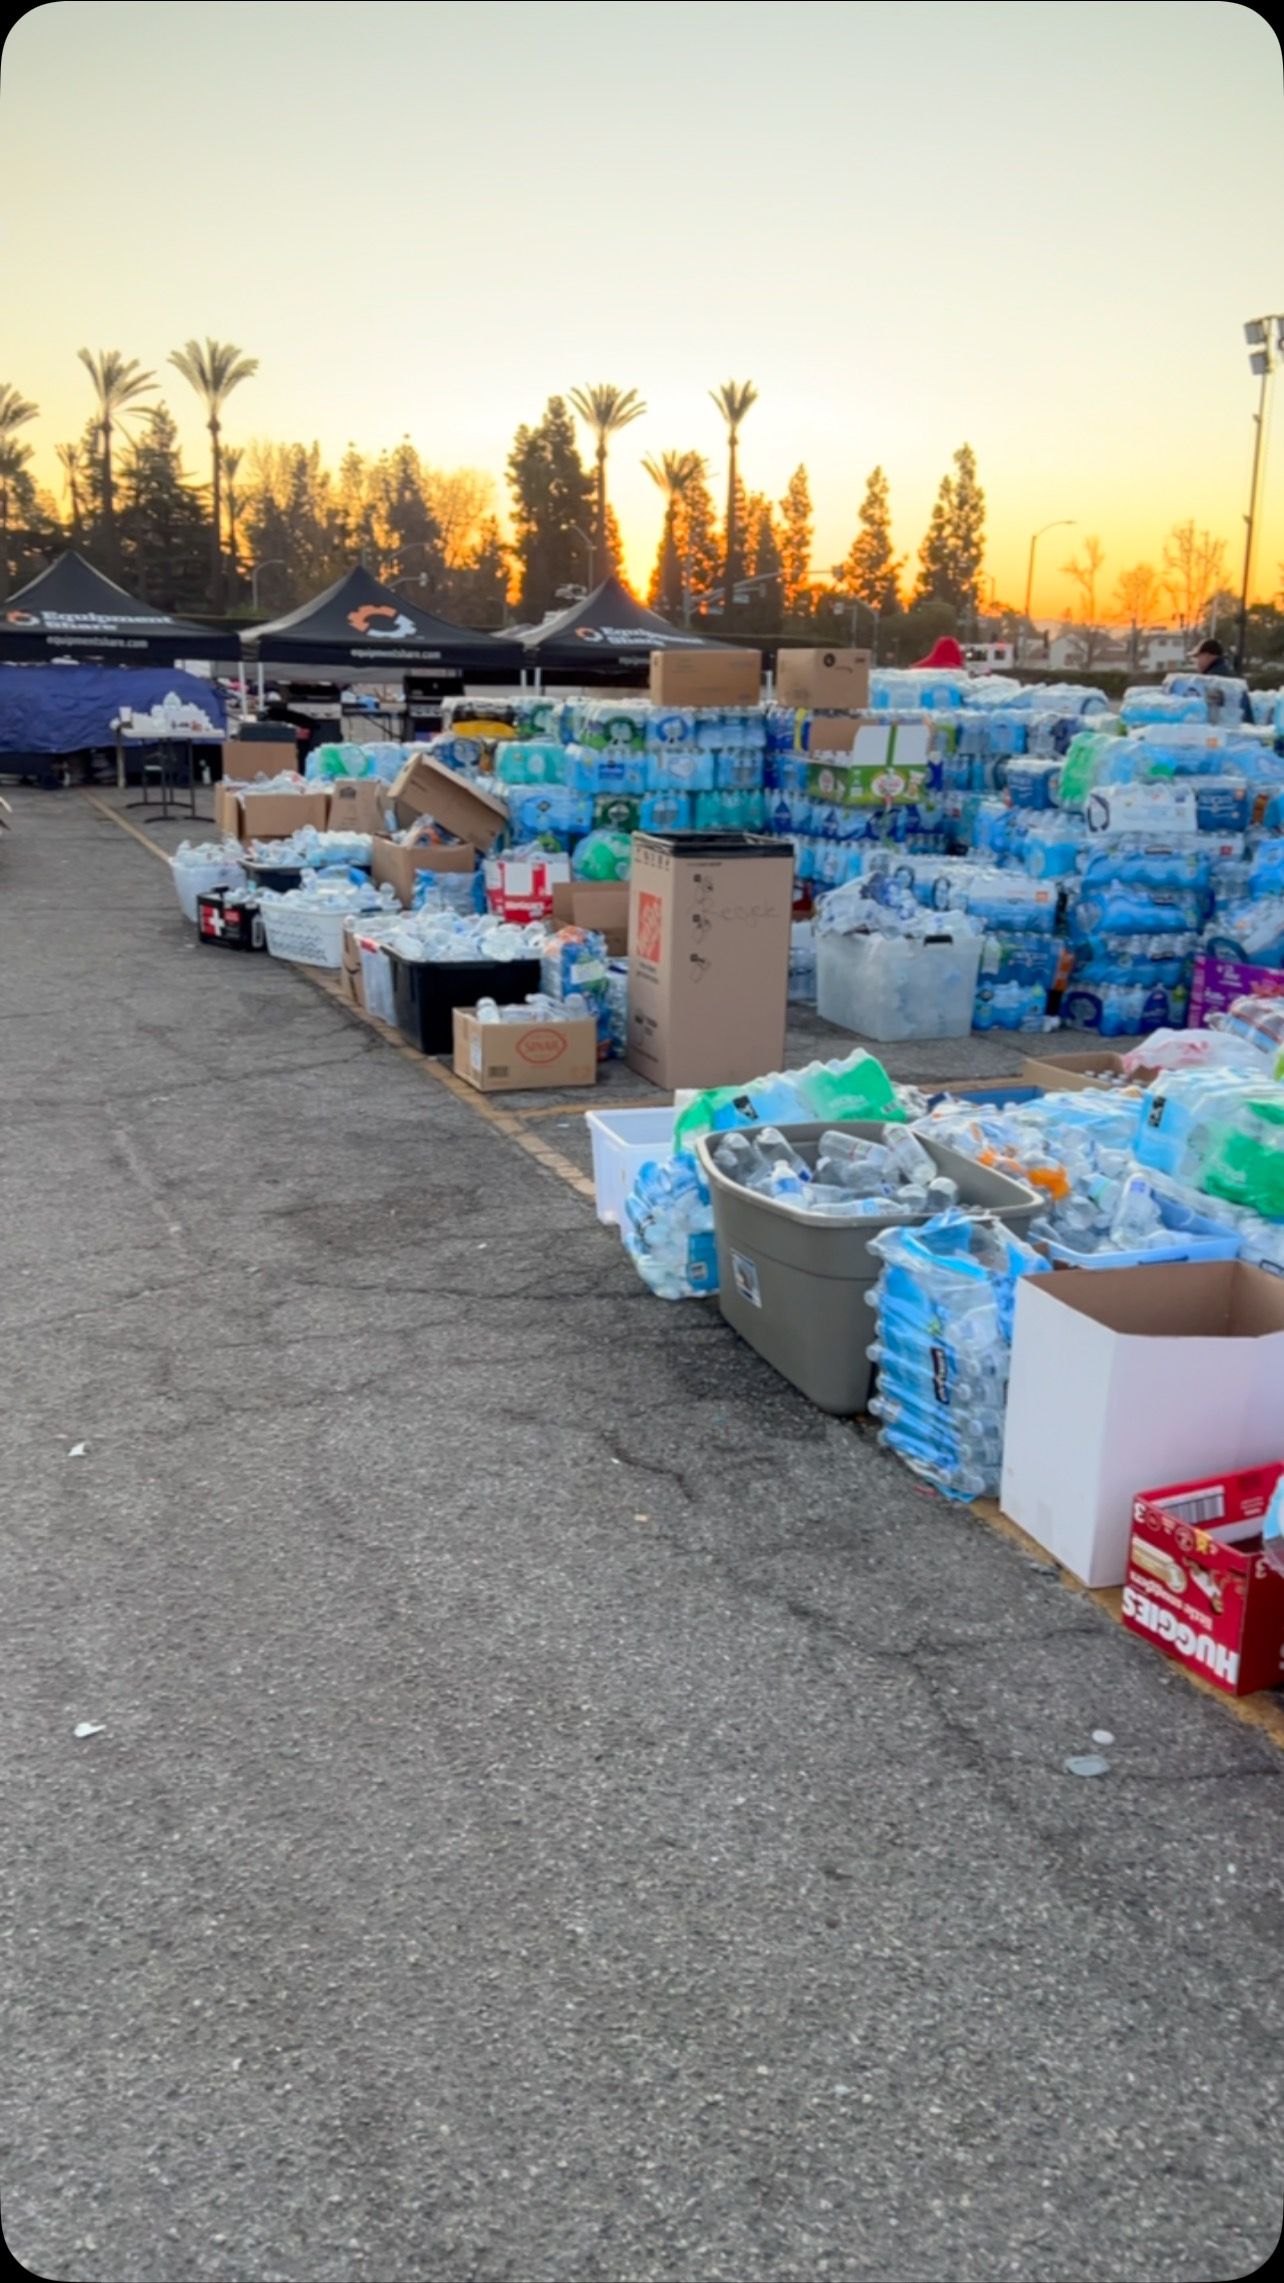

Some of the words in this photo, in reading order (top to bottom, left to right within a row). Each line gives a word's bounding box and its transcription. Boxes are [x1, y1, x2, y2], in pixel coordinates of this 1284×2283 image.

[41, 611, 175, 624] Equipment
[601, 626, 706, 644] Equip
[1133, 1502, 1147, 1523] 3
[1255, 1558, 1268, 1579] 3
[1121, 1586, 1240, 1685] HUGGIES
